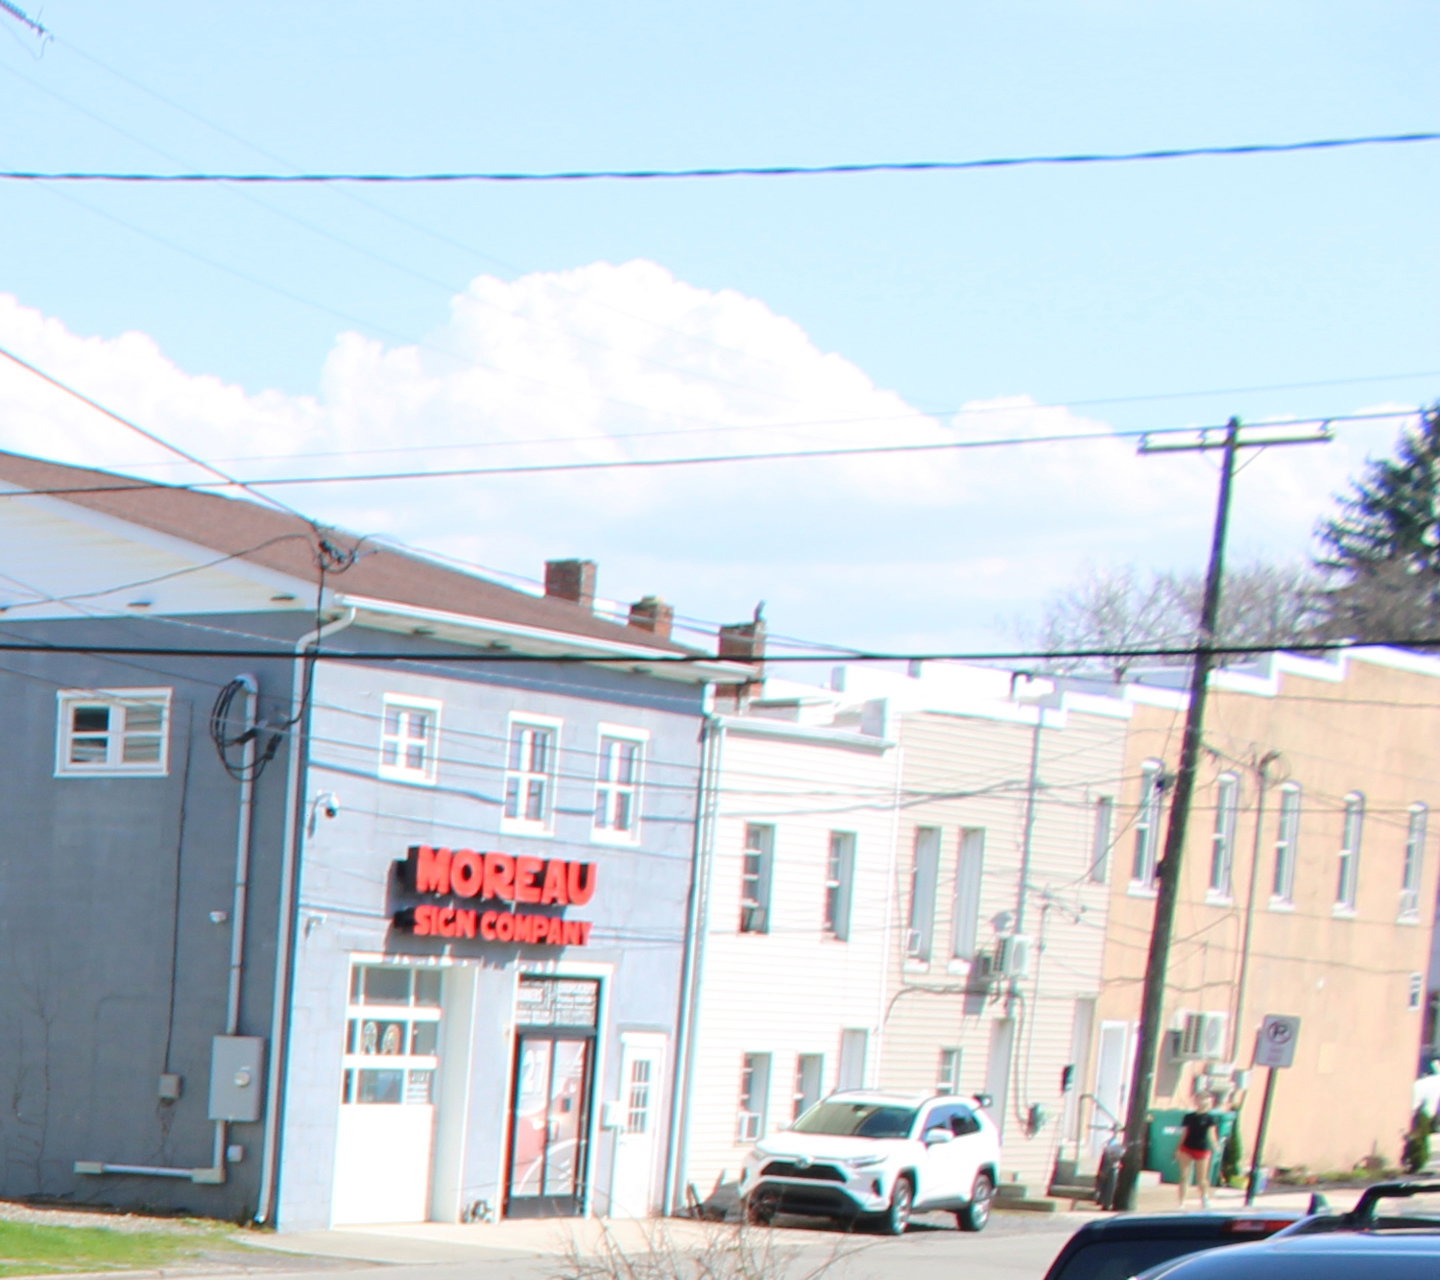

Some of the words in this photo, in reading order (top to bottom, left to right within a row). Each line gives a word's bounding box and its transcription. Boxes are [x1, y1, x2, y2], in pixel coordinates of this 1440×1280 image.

[415, 845, 598, 906] MOREAU
[413, 905, 476, 938] SIGN
[481, 910, 594, 946] COMPANY
